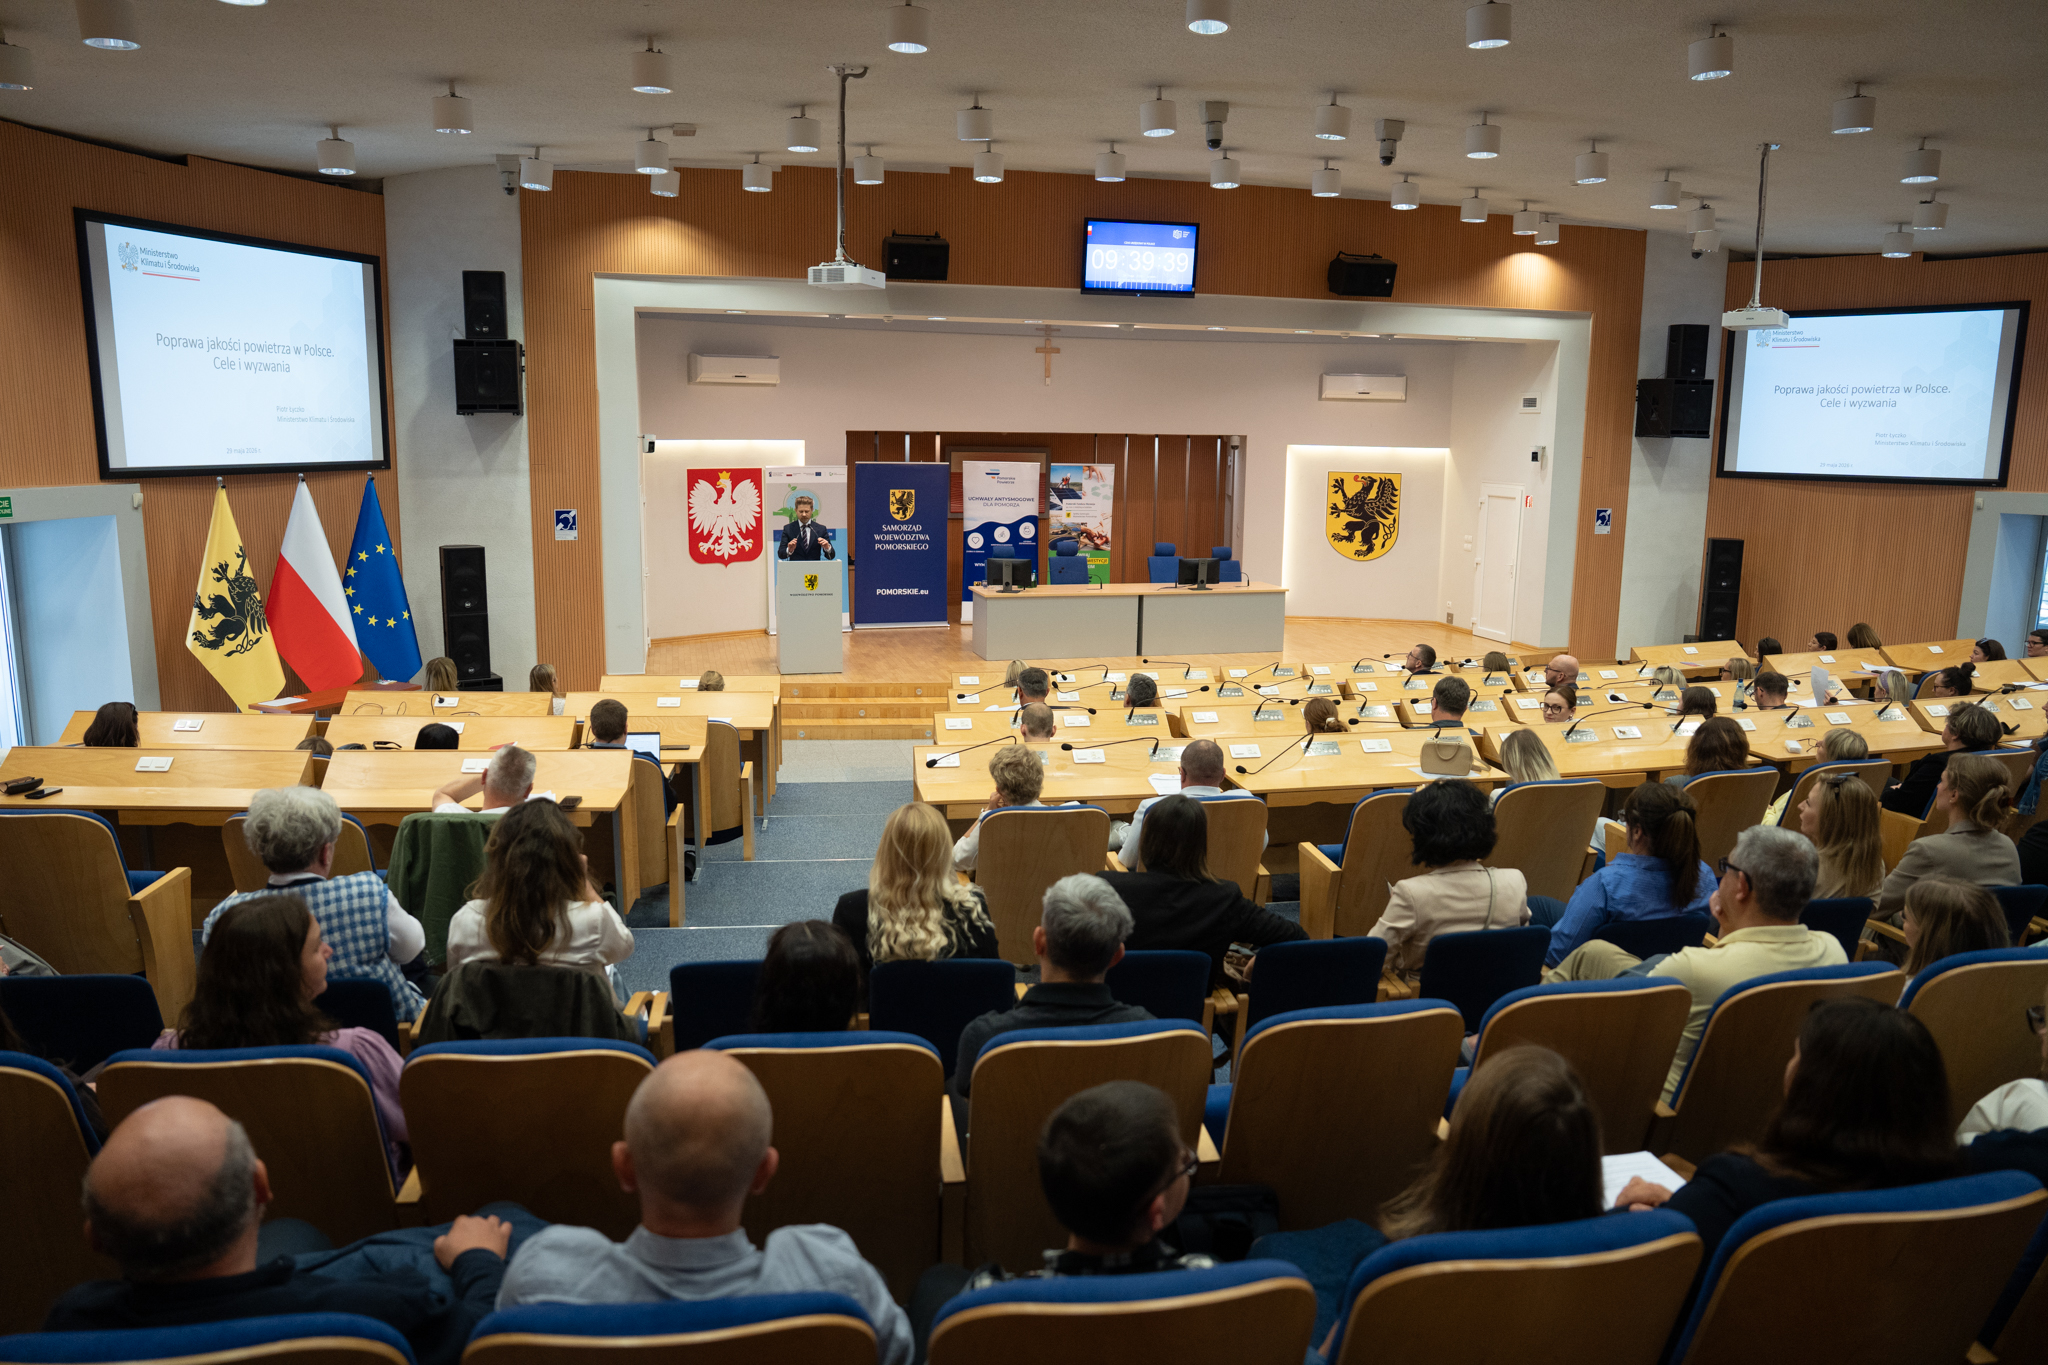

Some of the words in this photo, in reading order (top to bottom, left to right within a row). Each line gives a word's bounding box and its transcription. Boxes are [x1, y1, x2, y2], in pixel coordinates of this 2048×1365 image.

[140, 247, 178, 259] Ministerstwo
[141, 258, 164, 268] Klimatu
[167, 260, 200, 272] Środowiska
[156, 333, 204, 350] Poprawa
[206, 336, 241, 353] jakości
[244, 341, 291, 355] powietrza
[293, 346, 302, 355] w
[304, 344, 335, 358] Polsce.
[213, 356, 236, 370] Cele
[244, 361, 291, 374] wyzwania
[1774, 385, 1815, 397] Poprawa
[1815, 384, 1849, 397] jakości
[1851, 384, 1900, 396] powietrza
[1903, 386, 1913, 394] w
[1915, 383, 1951, 394] Polsce.
[276, 405, 288, 413] Piotr
[1820, 398, 1842, 408] Cele
[1849, 398, 1897, 410] wyzwania
[330, 415, 355, 423] Środowiska
[882, 524, 922, 532] SAMORZĄD
[874, 532, 930, 541] WOJEWÓDZTWA
[876, 588, 929, 596] POMORSKIE.eu
